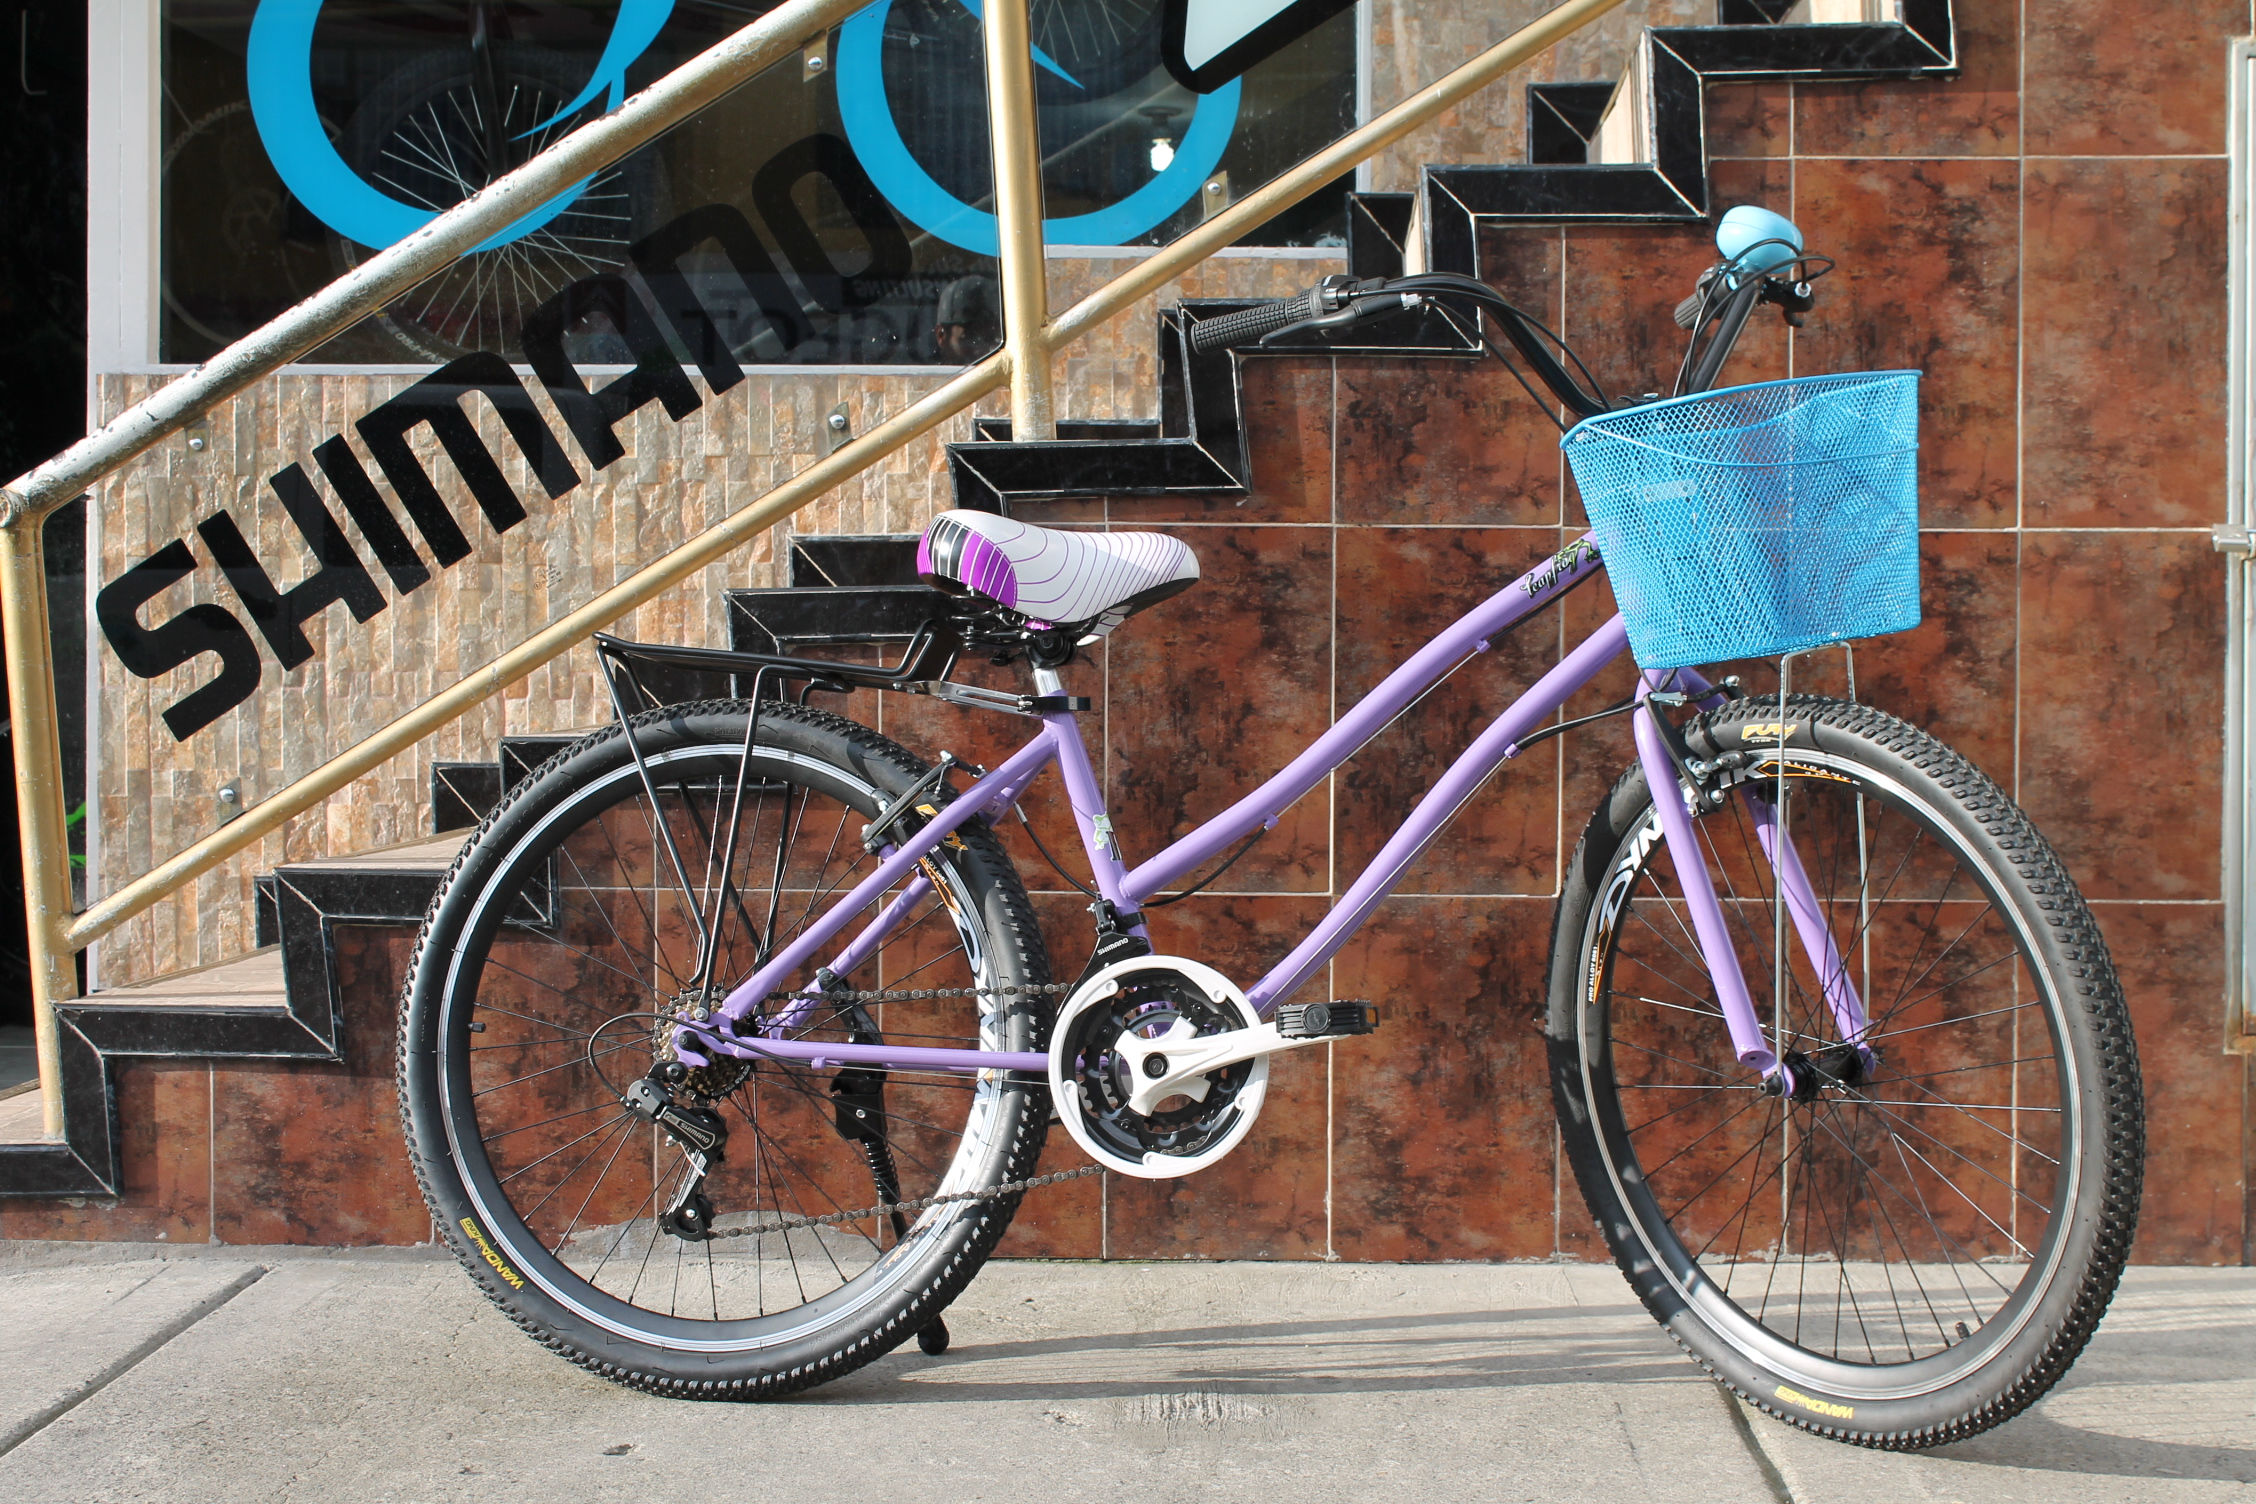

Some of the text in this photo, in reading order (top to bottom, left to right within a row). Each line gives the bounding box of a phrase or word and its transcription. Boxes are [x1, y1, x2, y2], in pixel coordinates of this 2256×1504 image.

[95, 133, 912, 742] SHIMANO
[1741, 723, 1798, 740] FURY
[1097, 937, 1129, 956] SHIMANO
[679, 1121, 711, 1144] SHIMANO
[481, 1243, 525, 1290] WANDA
[1806, 1398, 1855, 1419] WANDA
